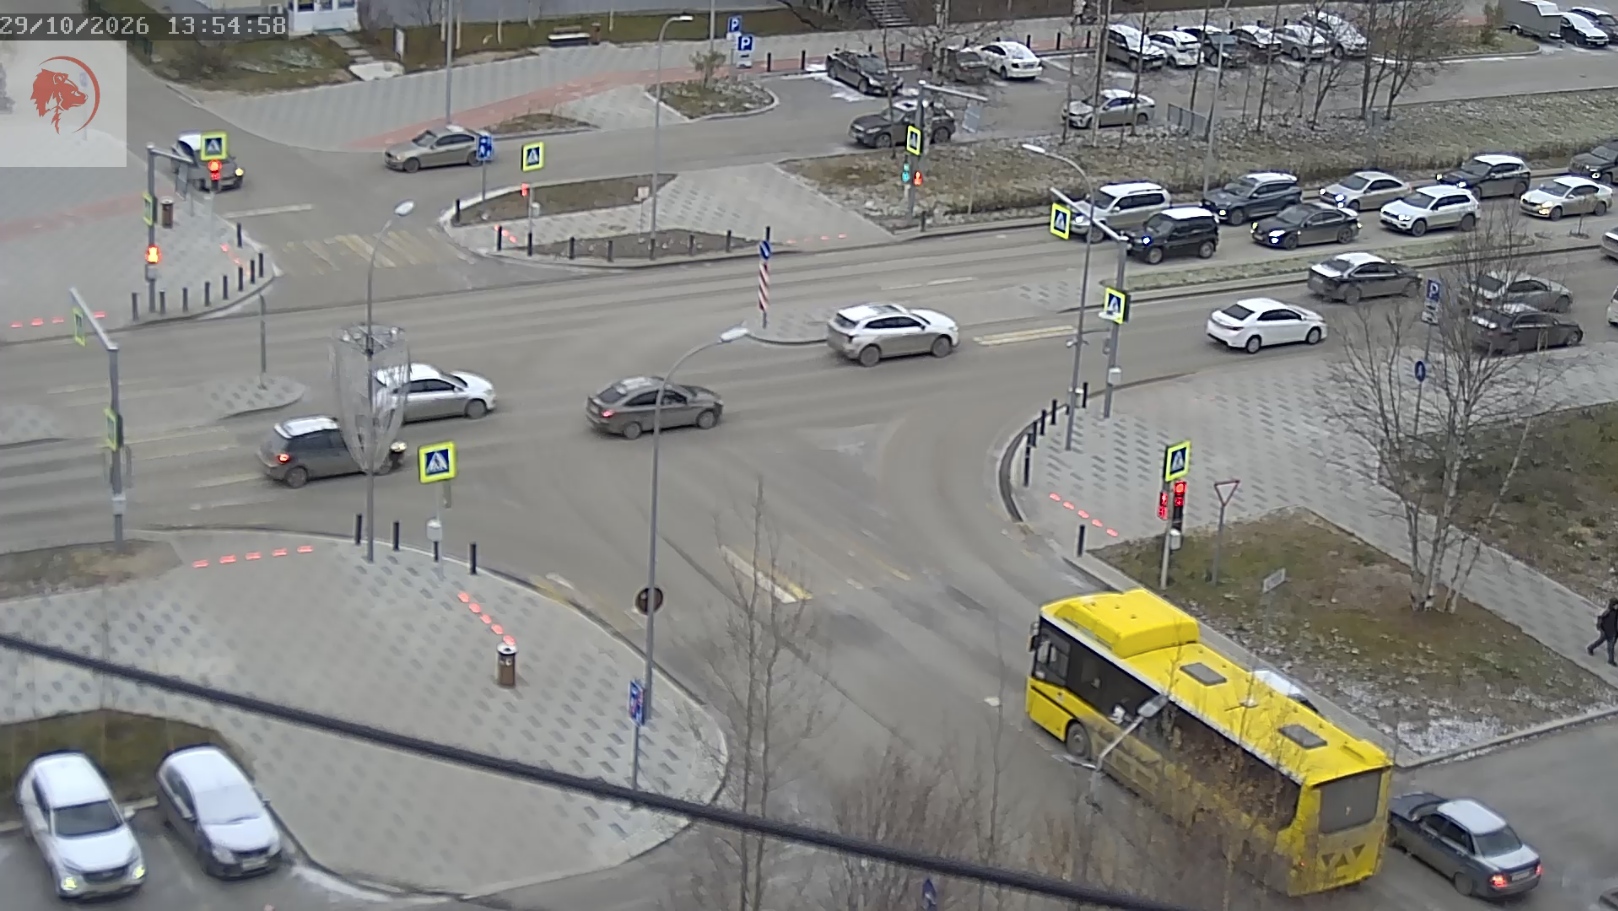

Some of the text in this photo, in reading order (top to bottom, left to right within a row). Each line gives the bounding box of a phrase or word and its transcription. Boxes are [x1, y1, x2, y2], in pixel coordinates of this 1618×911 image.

[731, 17, 740, 31] P
[740, 37, 751, 50] P
[1429, 282, 1439, 298] P
